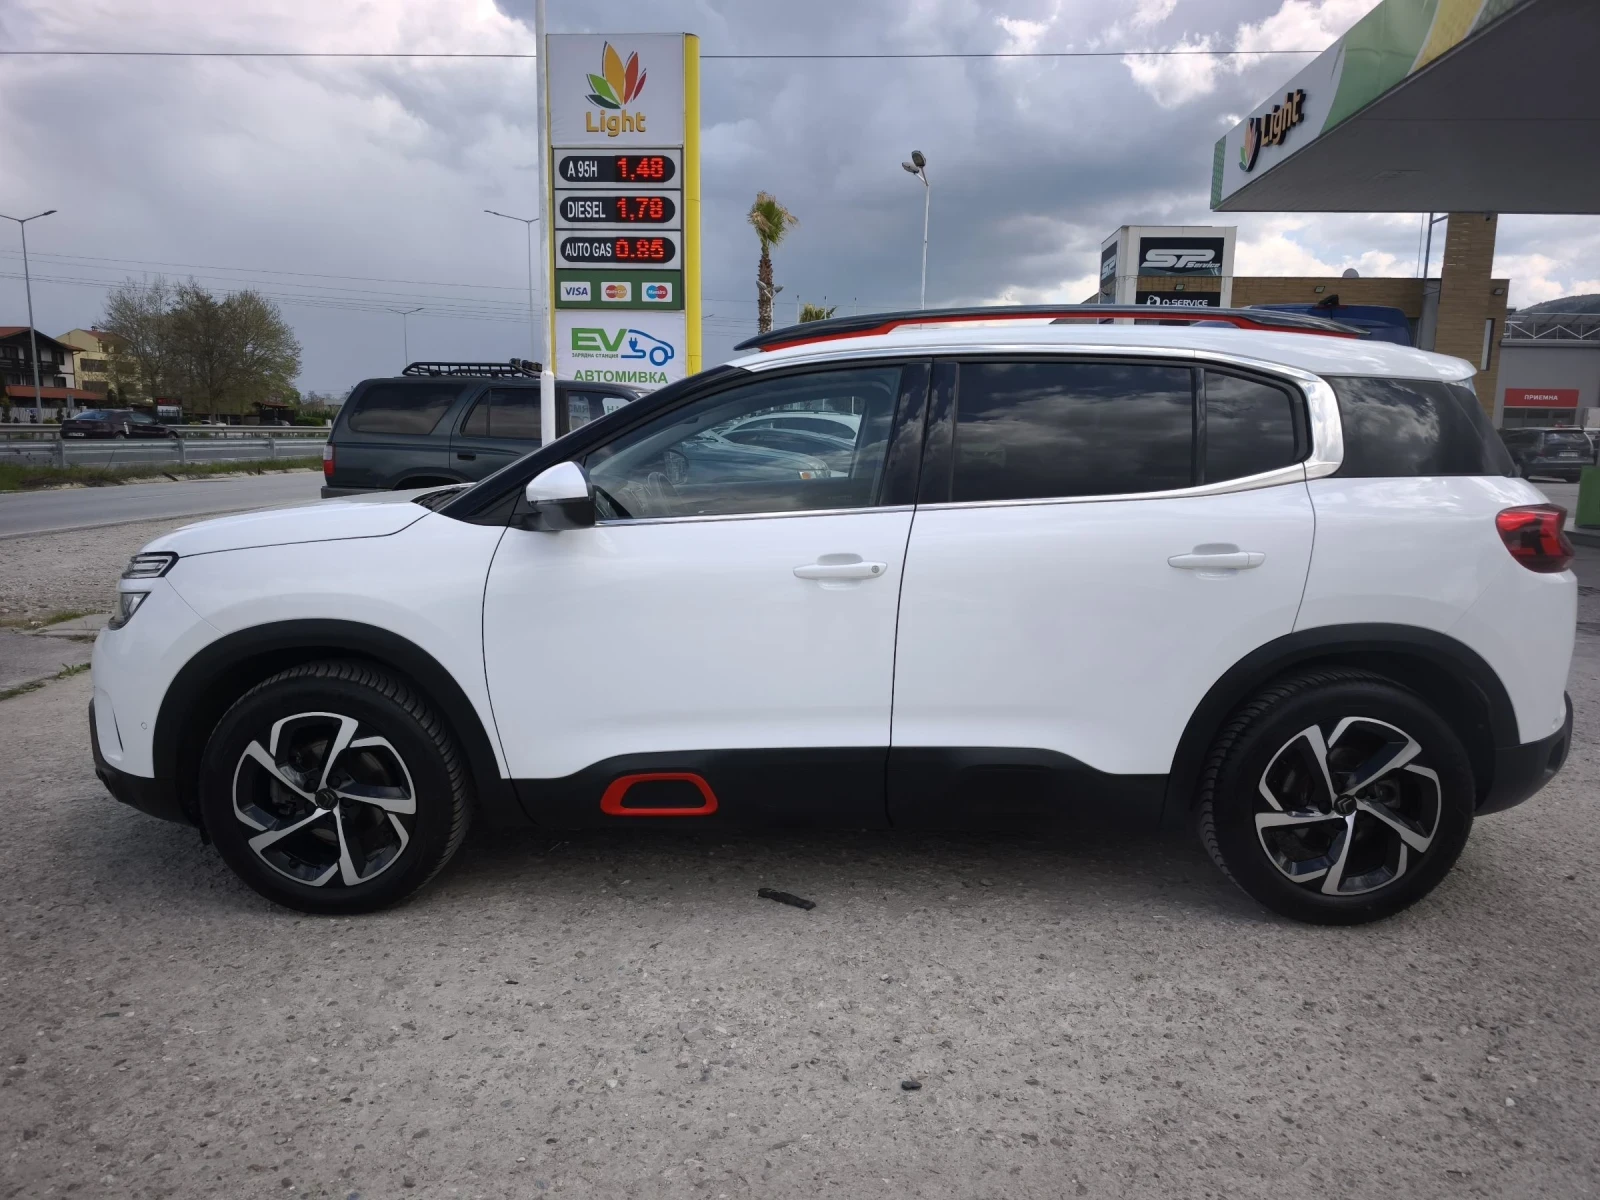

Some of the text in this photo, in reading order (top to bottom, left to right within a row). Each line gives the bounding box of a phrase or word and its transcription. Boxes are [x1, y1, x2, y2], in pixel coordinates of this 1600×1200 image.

[585, 109, 646, 137] Light
[1260, 89, 1306, 147] Light
[567, 160, 576, 177] A
[567, 201, 606, 218] DIESEL
[565, 242, 612, 257] AUTO GAS
[1185, 260, 1220, 268] Service
[564, 286, 588, 296] VISA
[571, 328, 628, 352] EV
[573, 369, 669, 384] АВТОМИВКА
